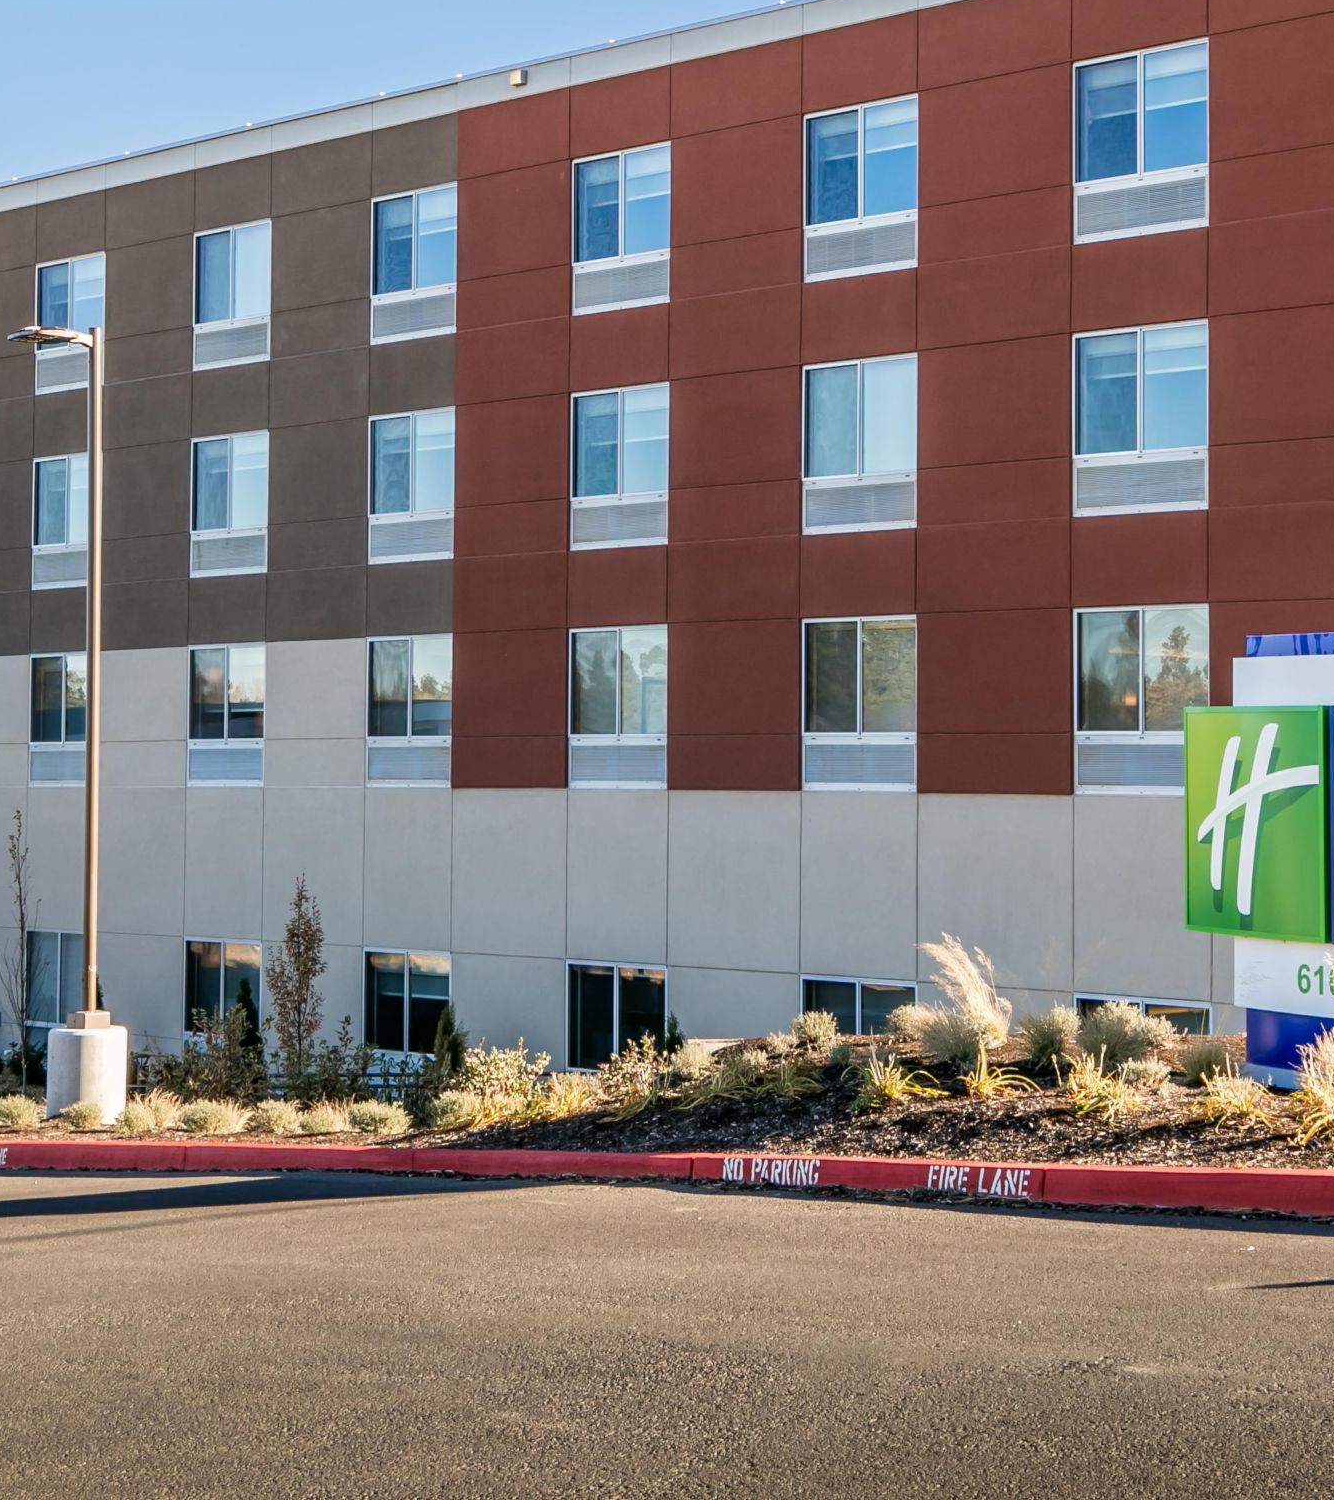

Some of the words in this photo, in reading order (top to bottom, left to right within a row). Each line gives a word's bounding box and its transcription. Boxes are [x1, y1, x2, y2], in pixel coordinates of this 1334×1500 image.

[722, 1157, 744, 1181] NO
[750, 1158, 821, 1186] PARKING
[927, 1165, 970, 1192] FIRE
[977, 1167, 1031, 1197] LANE
